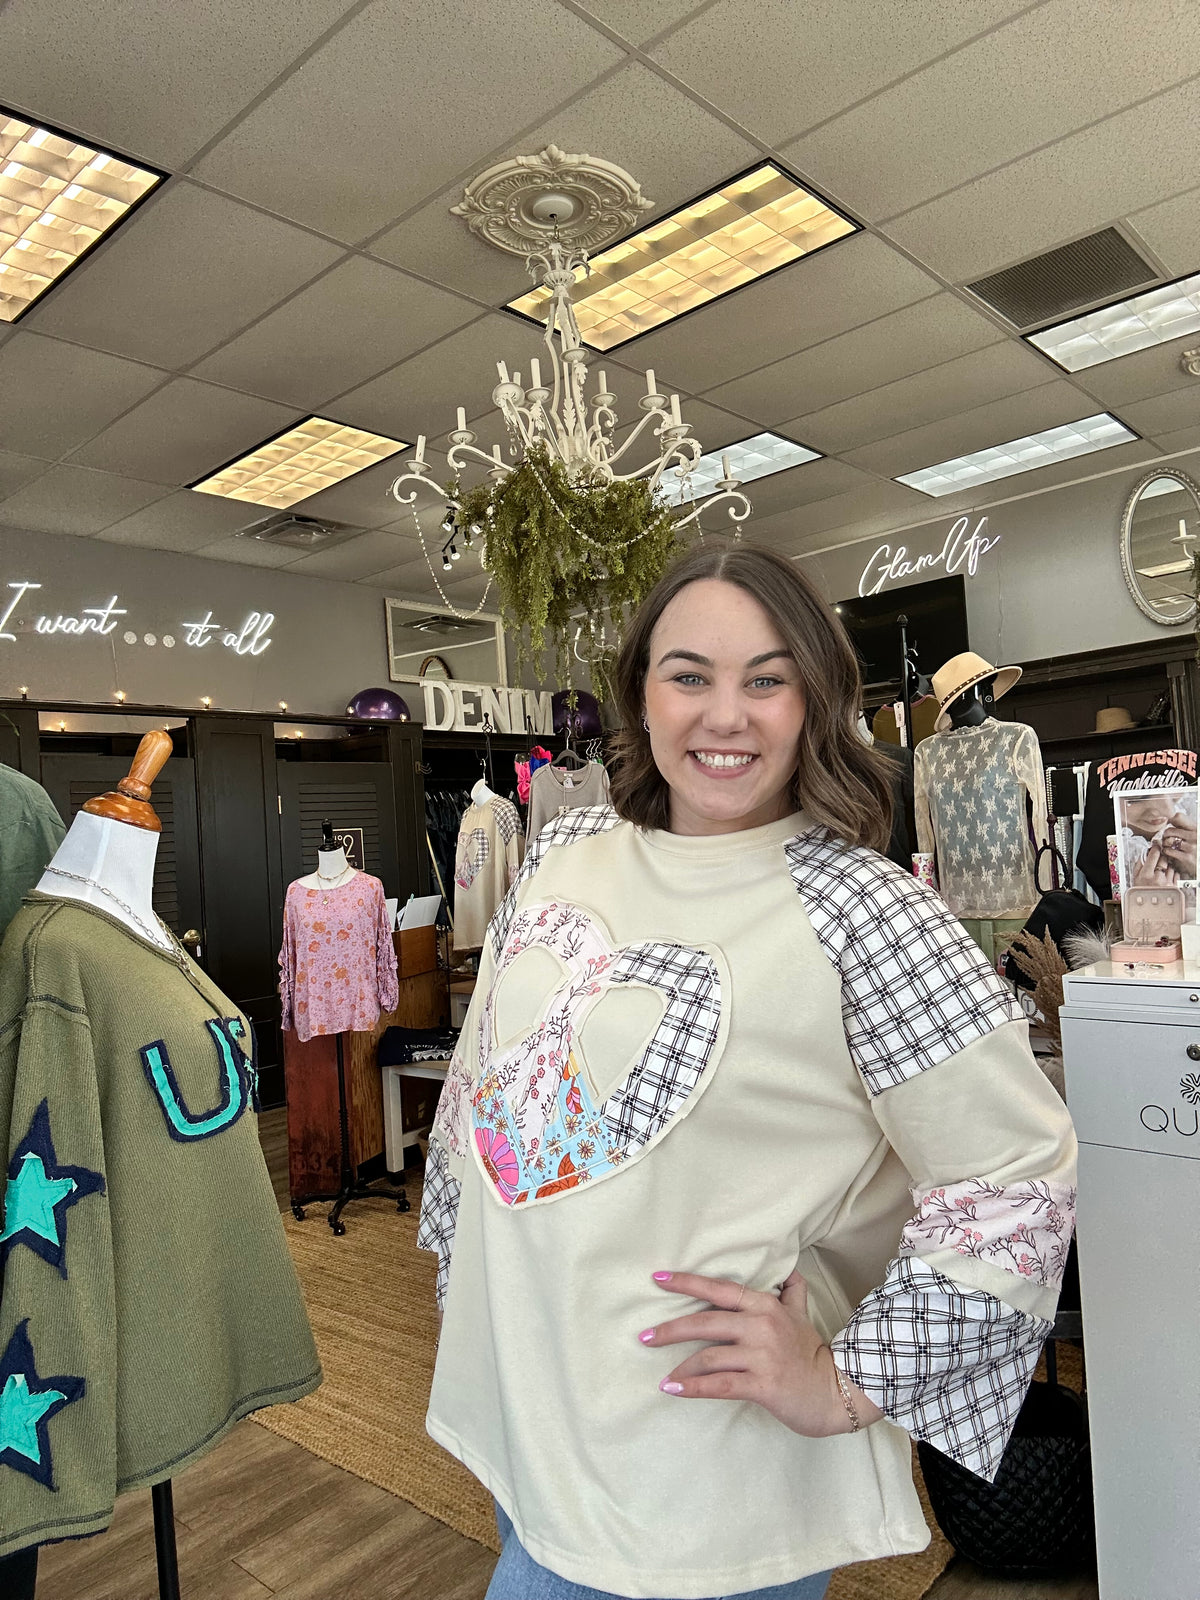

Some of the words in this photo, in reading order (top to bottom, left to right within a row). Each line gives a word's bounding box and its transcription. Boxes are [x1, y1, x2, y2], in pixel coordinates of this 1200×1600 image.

[858, 543, 944, 598] Glam
[943, 516, 1001, 577] Up
[0, 581, 42, 643] I
[36, 595, 128, 635] want
[182, 611, 221, 648] it
[223, 611, 275, 656] all
[420, 680, 556, 736] DENIM
[1096, 748, 1198, 789] TENNESSEE
[1106, 770, 1189, 799] Nashville
[1140, 1104, 1199, 1137] QU
